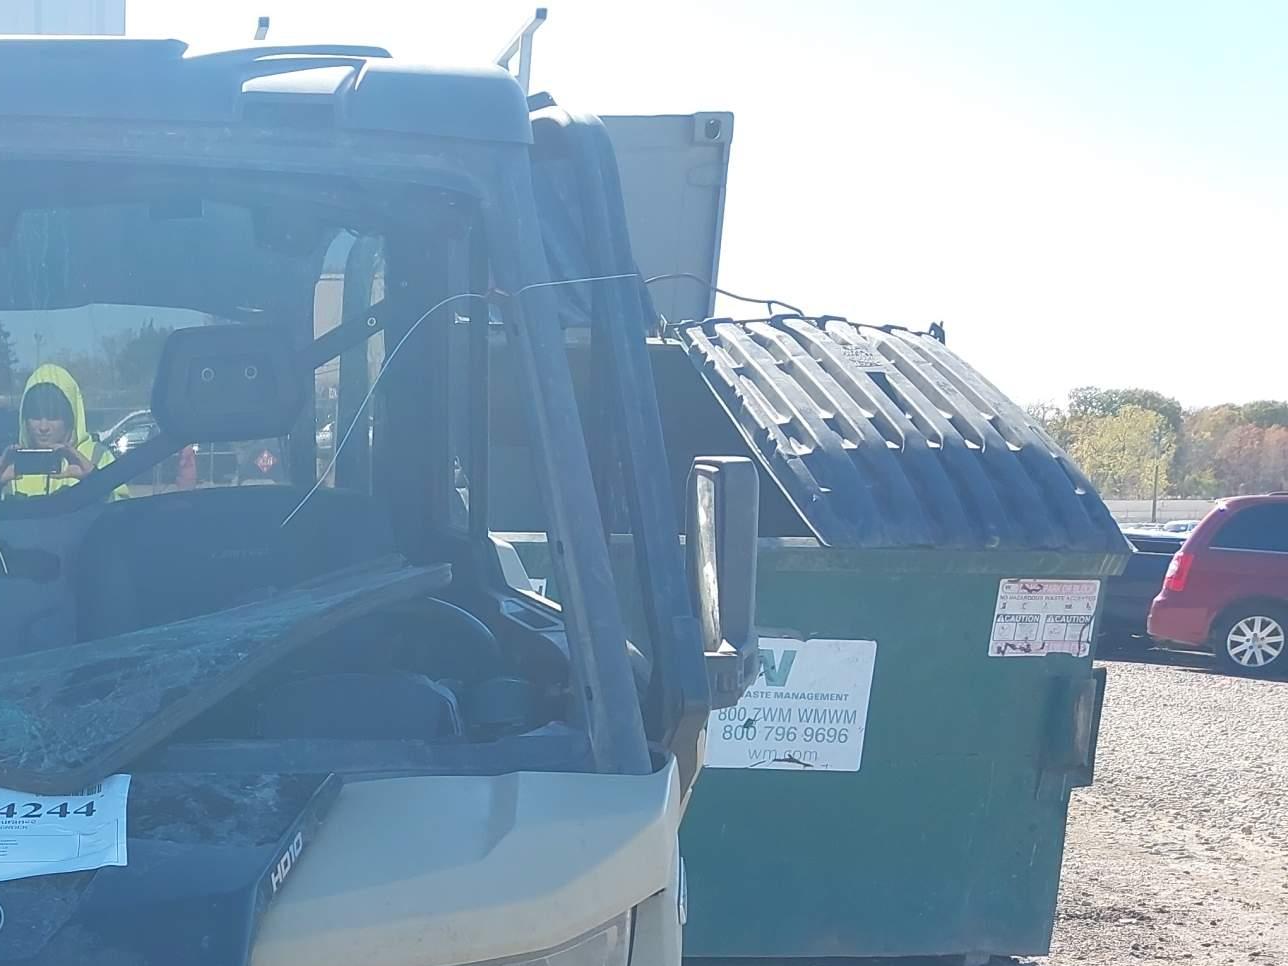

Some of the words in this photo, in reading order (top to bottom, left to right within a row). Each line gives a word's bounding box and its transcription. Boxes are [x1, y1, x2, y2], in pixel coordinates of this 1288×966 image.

[1005, 615, 1040, 623] CAUTION
[1054, 615, 1091, 623] CAUTION
[744, 691, 772, 700] ASTE
[774, 692, 850, 702] MANAGEMENT
[718, 708, 747, 722] 800
[753, 708, 792, 723] 7WM
[798, 708, 858, 724] WMWM
[722, 725, 757, 741] 800
[764, 726, 797, 742] 796
[803, 728, 849, 744] 9696
[748, 748, 818, 761] wm.com
[271, 832, 302, 892] HD10
